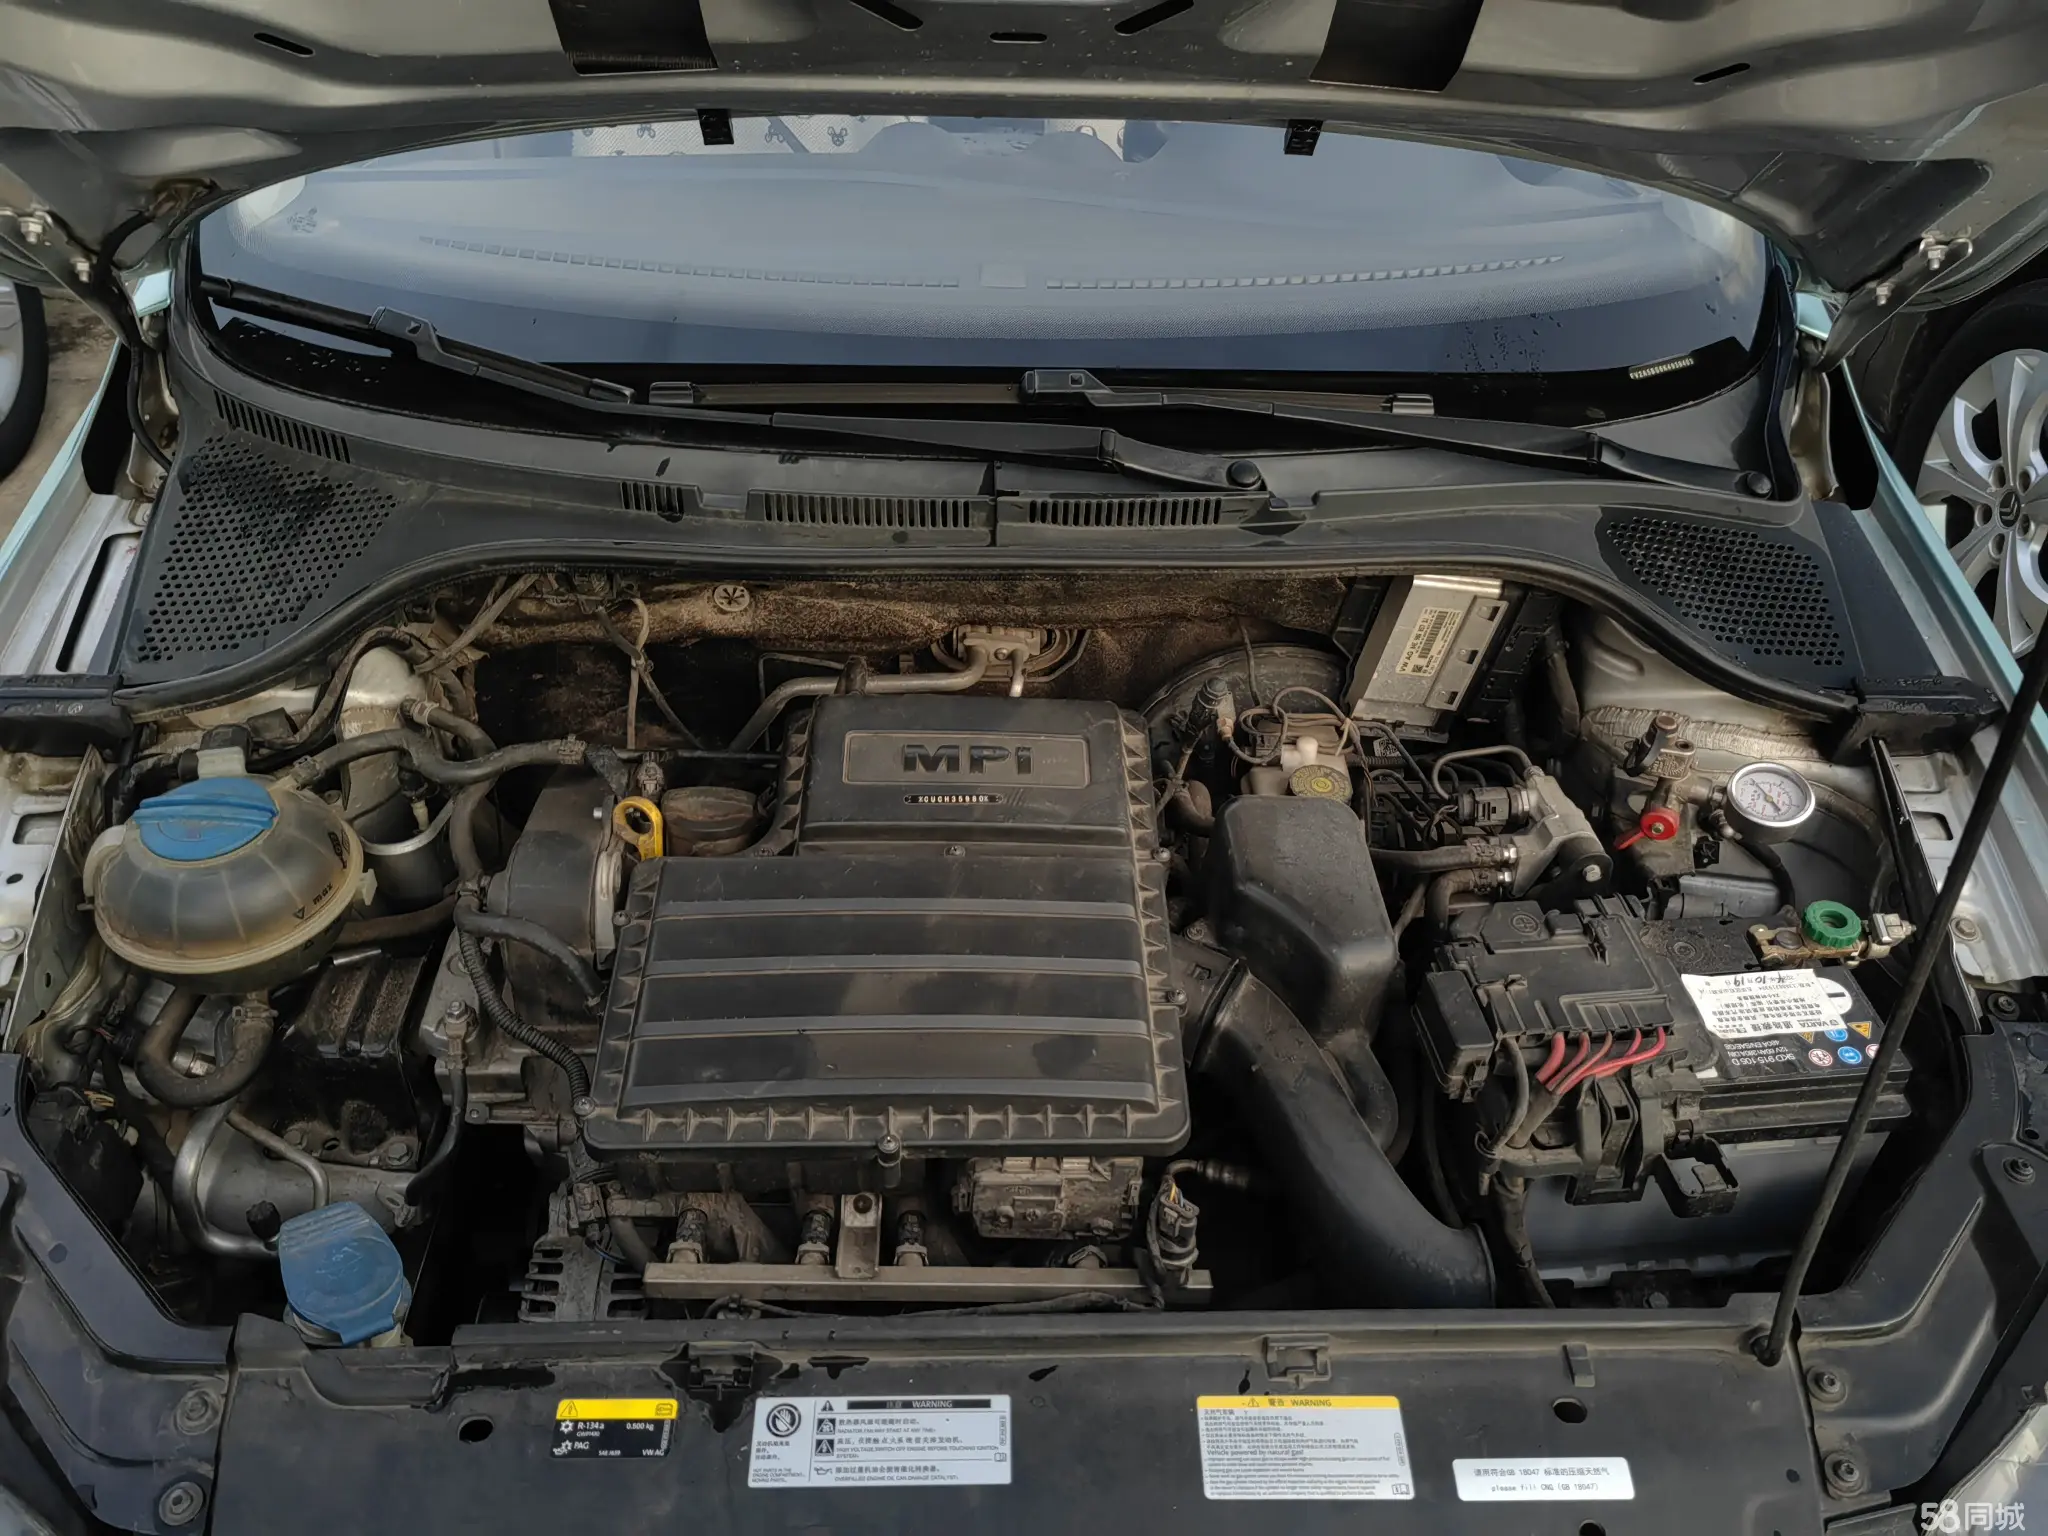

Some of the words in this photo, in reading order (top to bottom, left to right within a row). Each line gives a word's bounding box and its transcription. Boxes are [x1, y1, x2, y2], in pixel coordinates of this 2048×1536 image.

[312, 882, 333, 905] max
[1757, 1055, 1775, 1064] 915
[912, 1400, 953, 1409] WARNING
[1290, 1398, 1332, 1407] WARNING
[646, 1422, 655, 1431] kg
[573, 1442, 590, 1450] PAG
[1259, 1449, 1266, 1457] by
[1519, 1468, 1540, 1476] 18047
